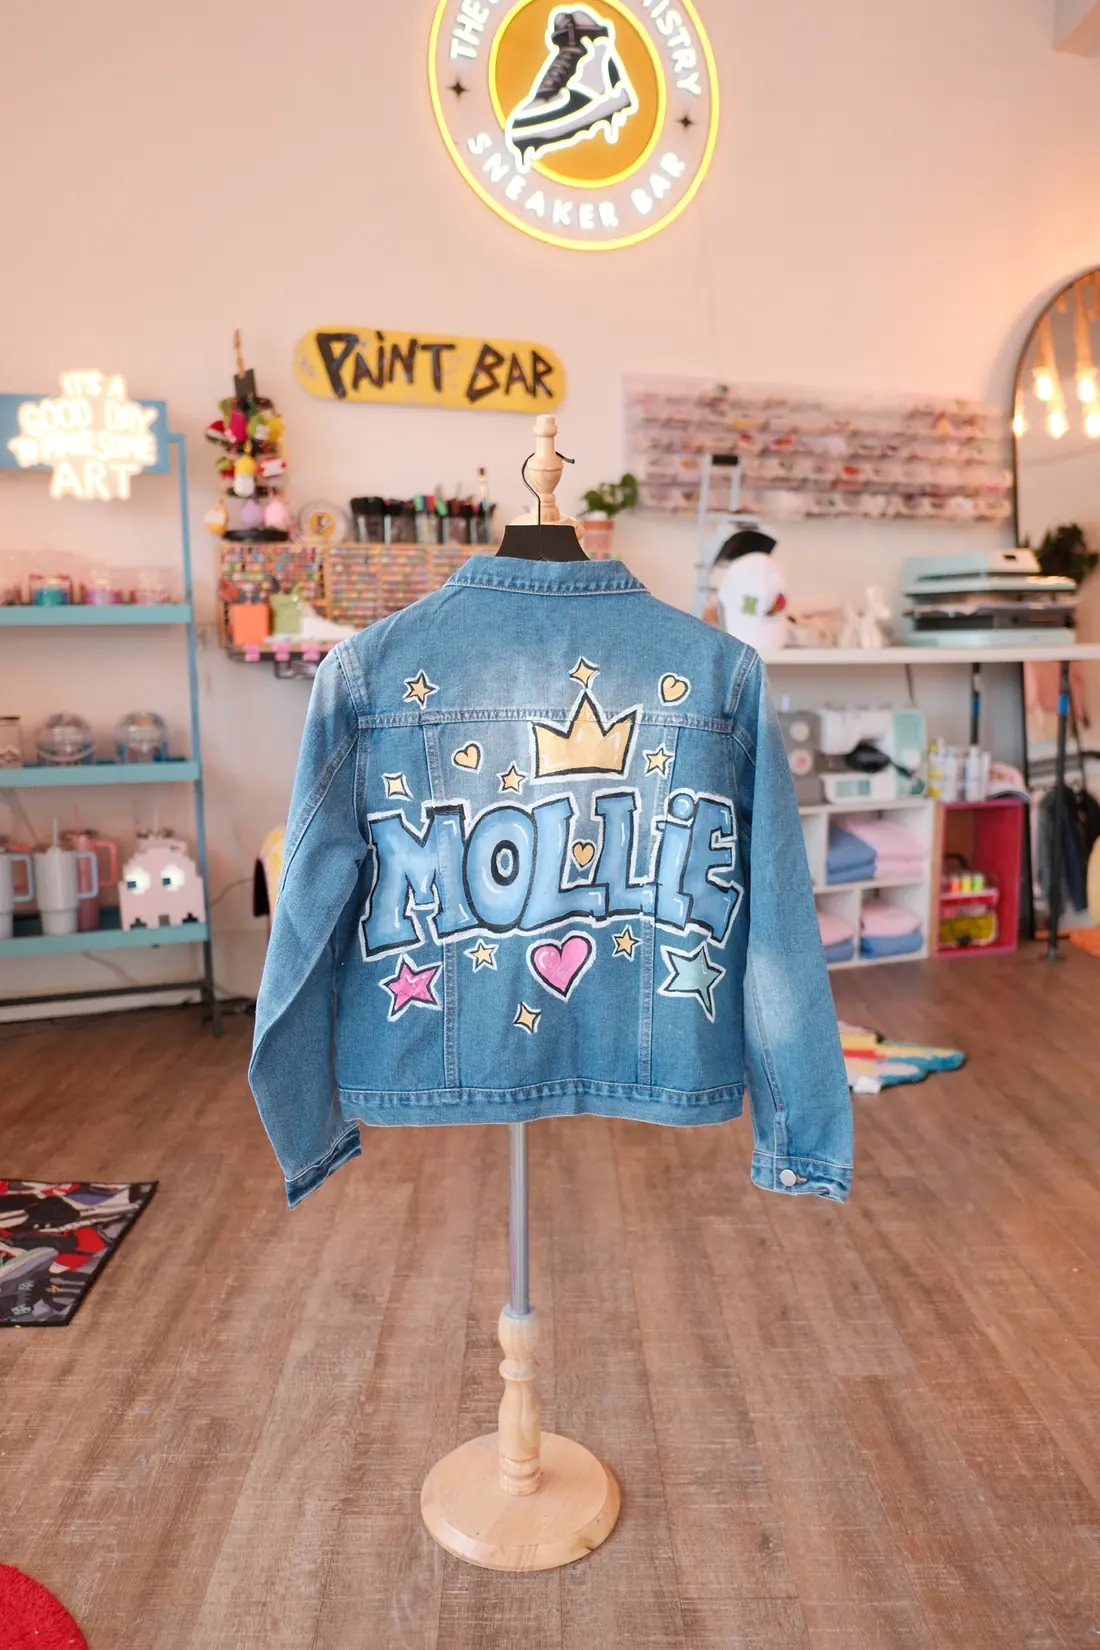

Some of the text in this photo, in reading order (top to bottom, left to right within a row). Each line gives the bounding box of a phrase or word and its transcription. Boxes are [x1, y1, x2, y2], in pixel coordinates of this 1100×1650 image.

[643, 0, 701, 95] ISTRY
[467, 132, 686, 229] SNEAKER BAR
[466, 343, 553, 404] BAR
[22, 398, 155, 436] GOOD DAY
[52, 460, 139, 497] ART
